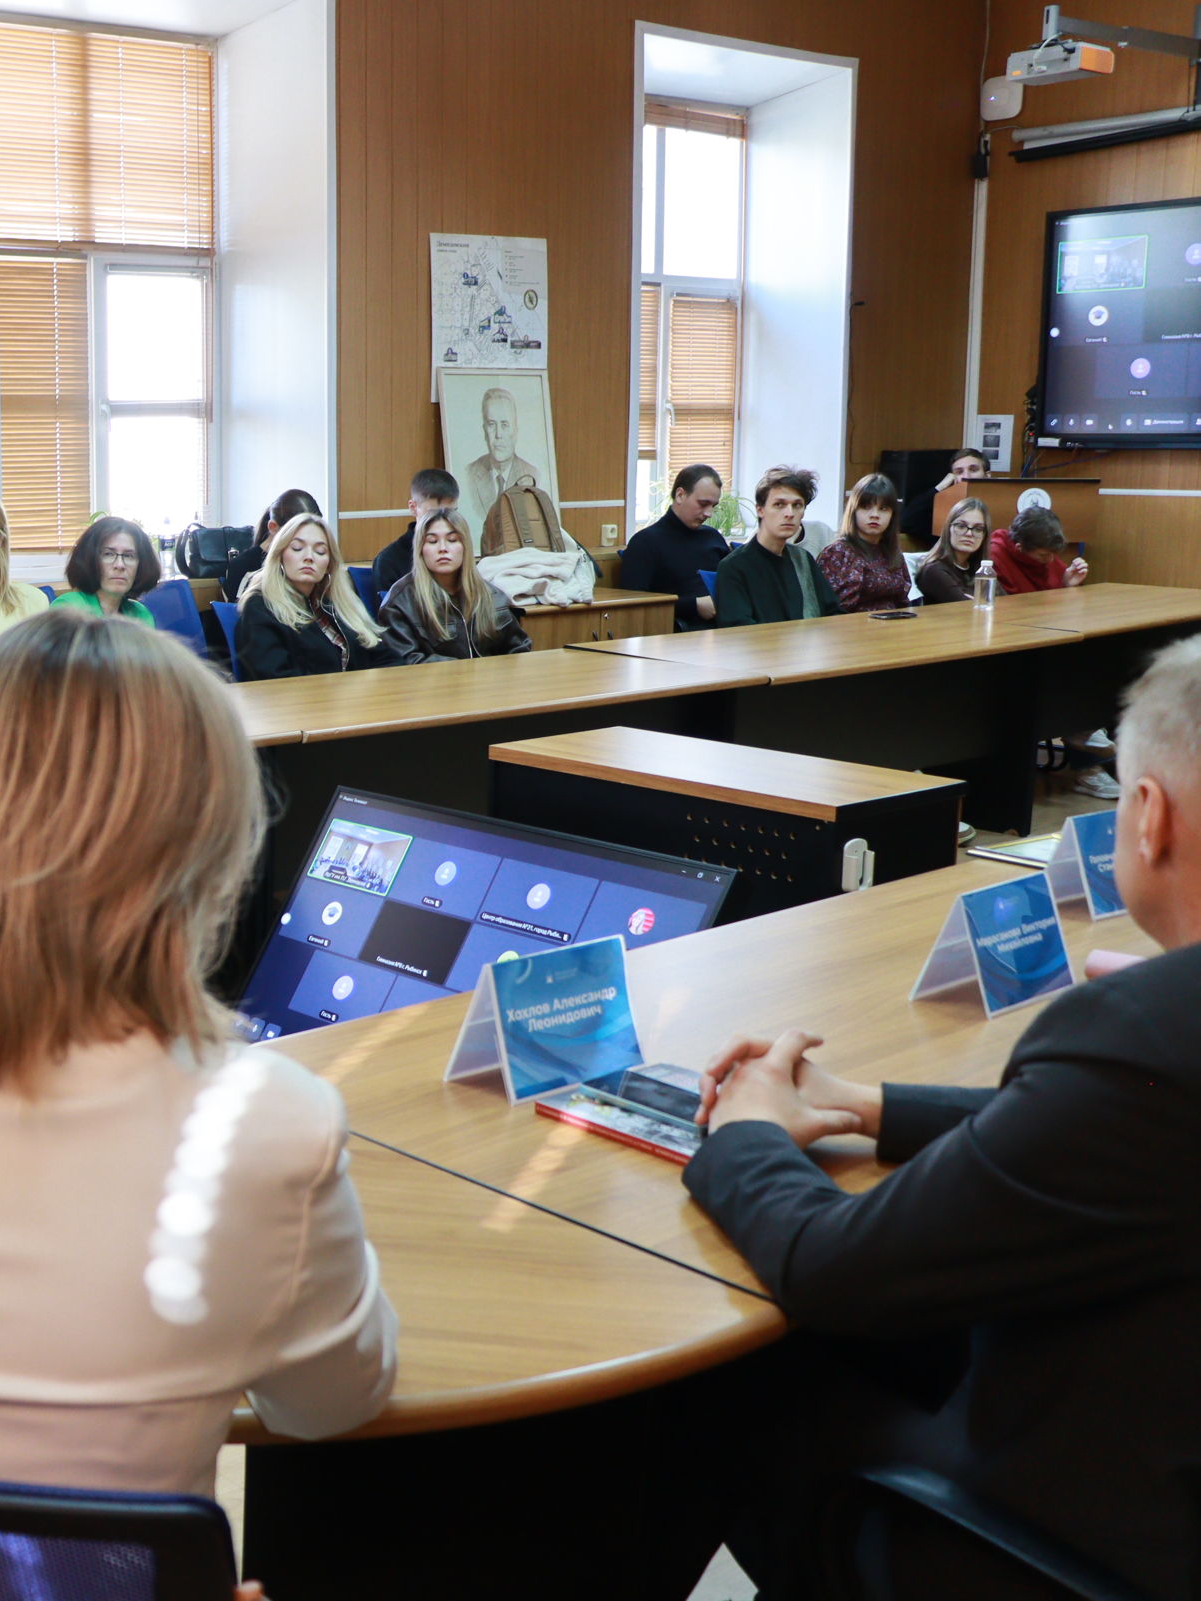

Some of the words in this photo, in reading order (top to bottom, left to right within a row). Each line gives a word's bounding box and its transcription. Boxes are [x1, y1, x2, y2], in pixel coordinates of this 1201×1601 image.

[481, 912, 496, 922] Центр
[495, 916, 522, 929] образования
[552, 986, 616, 1011] Александр
[527, 1005, 603, 1032] Леонидович
